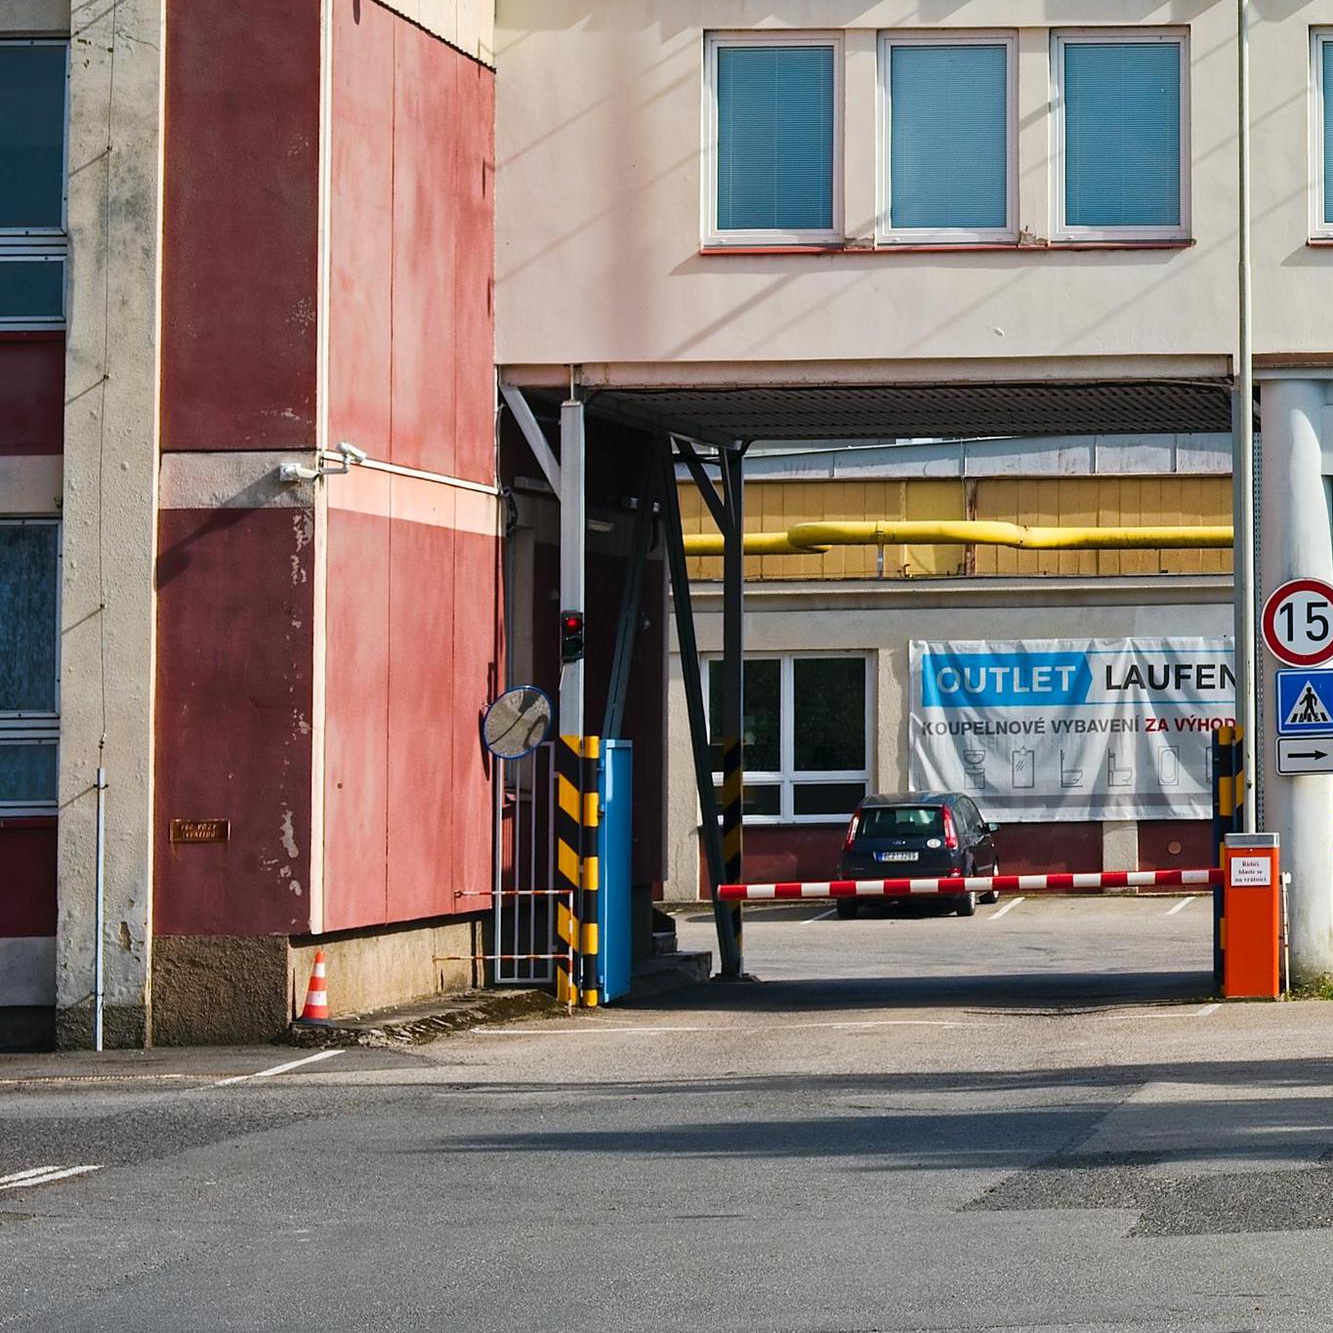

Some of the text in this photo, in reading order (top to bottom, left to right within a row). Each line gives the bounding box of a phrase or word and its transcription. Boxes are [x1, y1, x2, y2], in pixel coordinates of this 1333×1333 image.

[1279, 601, 1329, 642] 15
[936, 665, 1077, 695] OUTLET
[921, 717, 1046, 736] KOUPELNOVÉ
[1051, 714, 1140, 735] VYBAVENÍ
[1145, 718, 1169, 733] ZA
